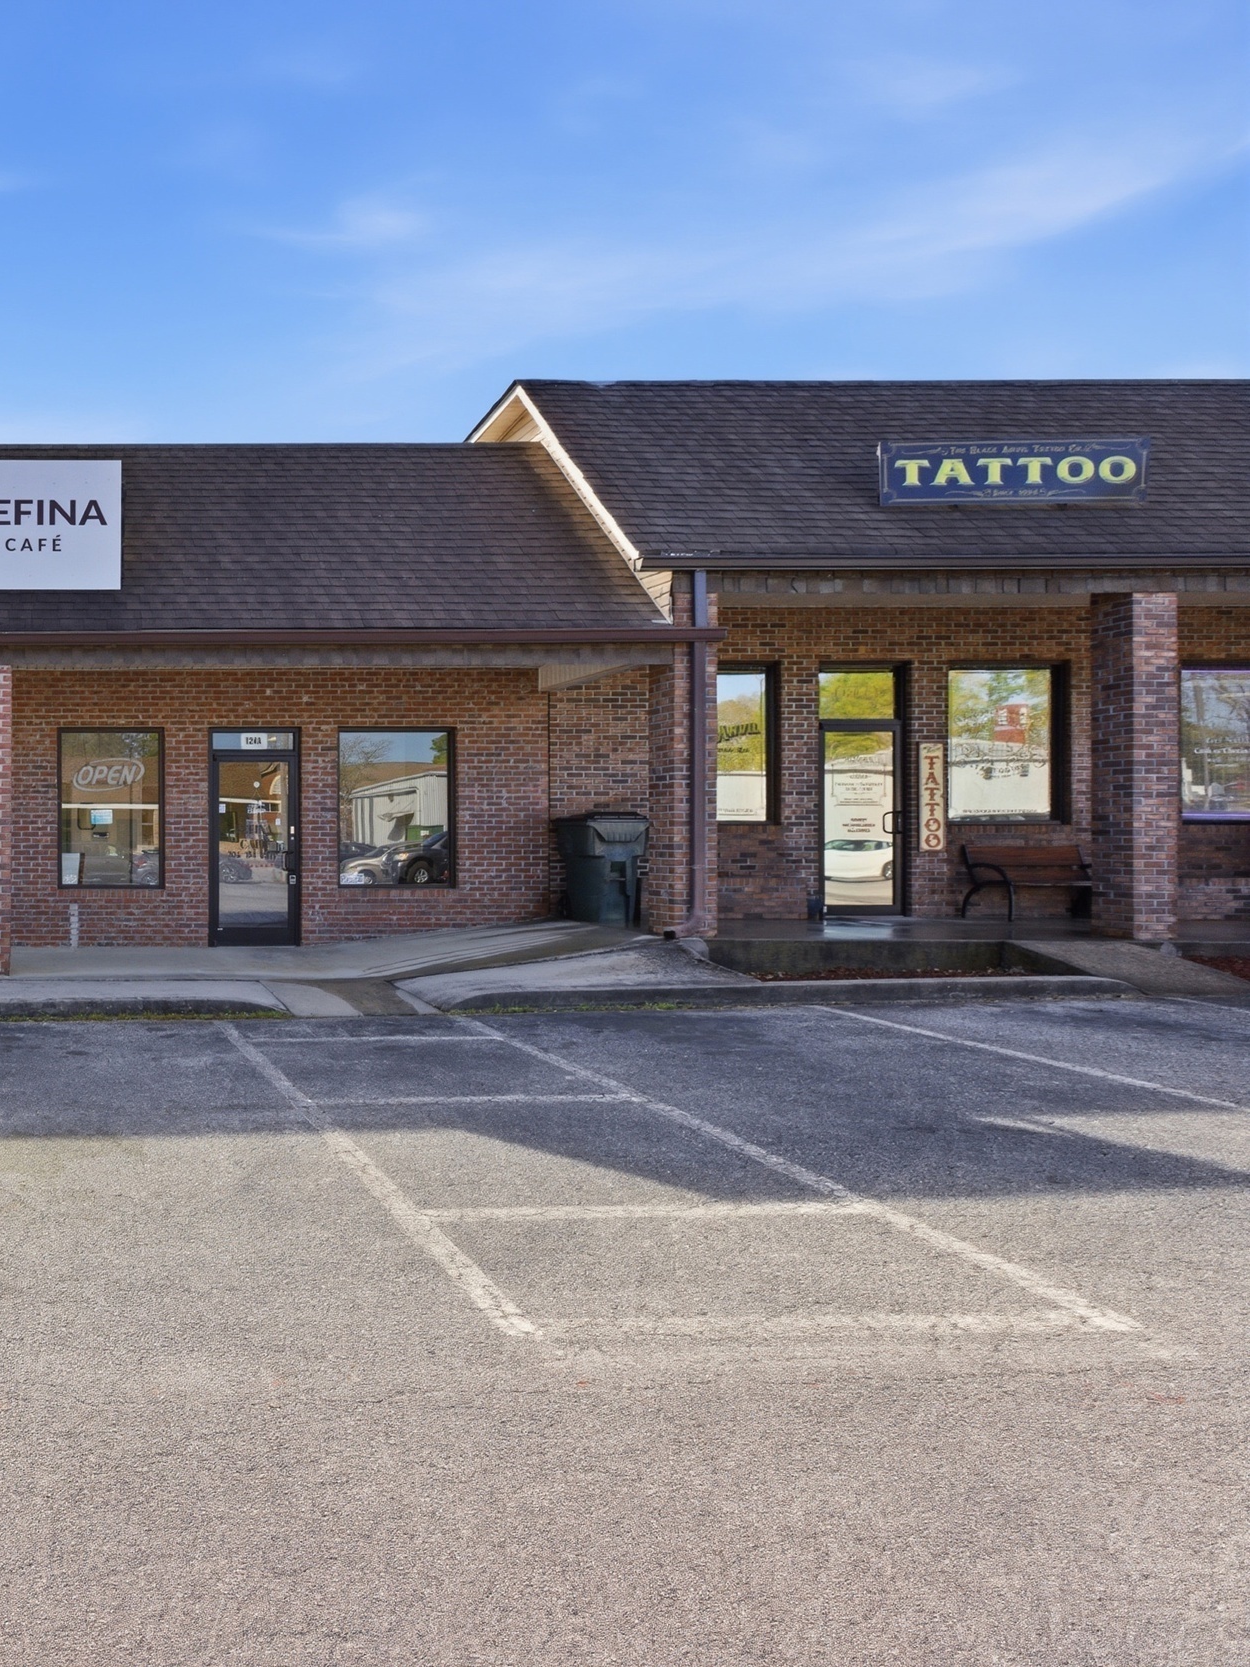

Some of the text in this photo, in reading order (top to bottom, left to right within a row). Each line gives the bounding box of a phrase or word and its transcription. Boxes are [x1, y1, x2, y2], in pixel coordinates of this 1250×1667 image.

[894, 455, 1137, 486] TATTOO
[5, 534, 62, 552] CAFÉ
[77, 765, 137, 785] OPEN
[924, 755, 941, 848] TATTOO
